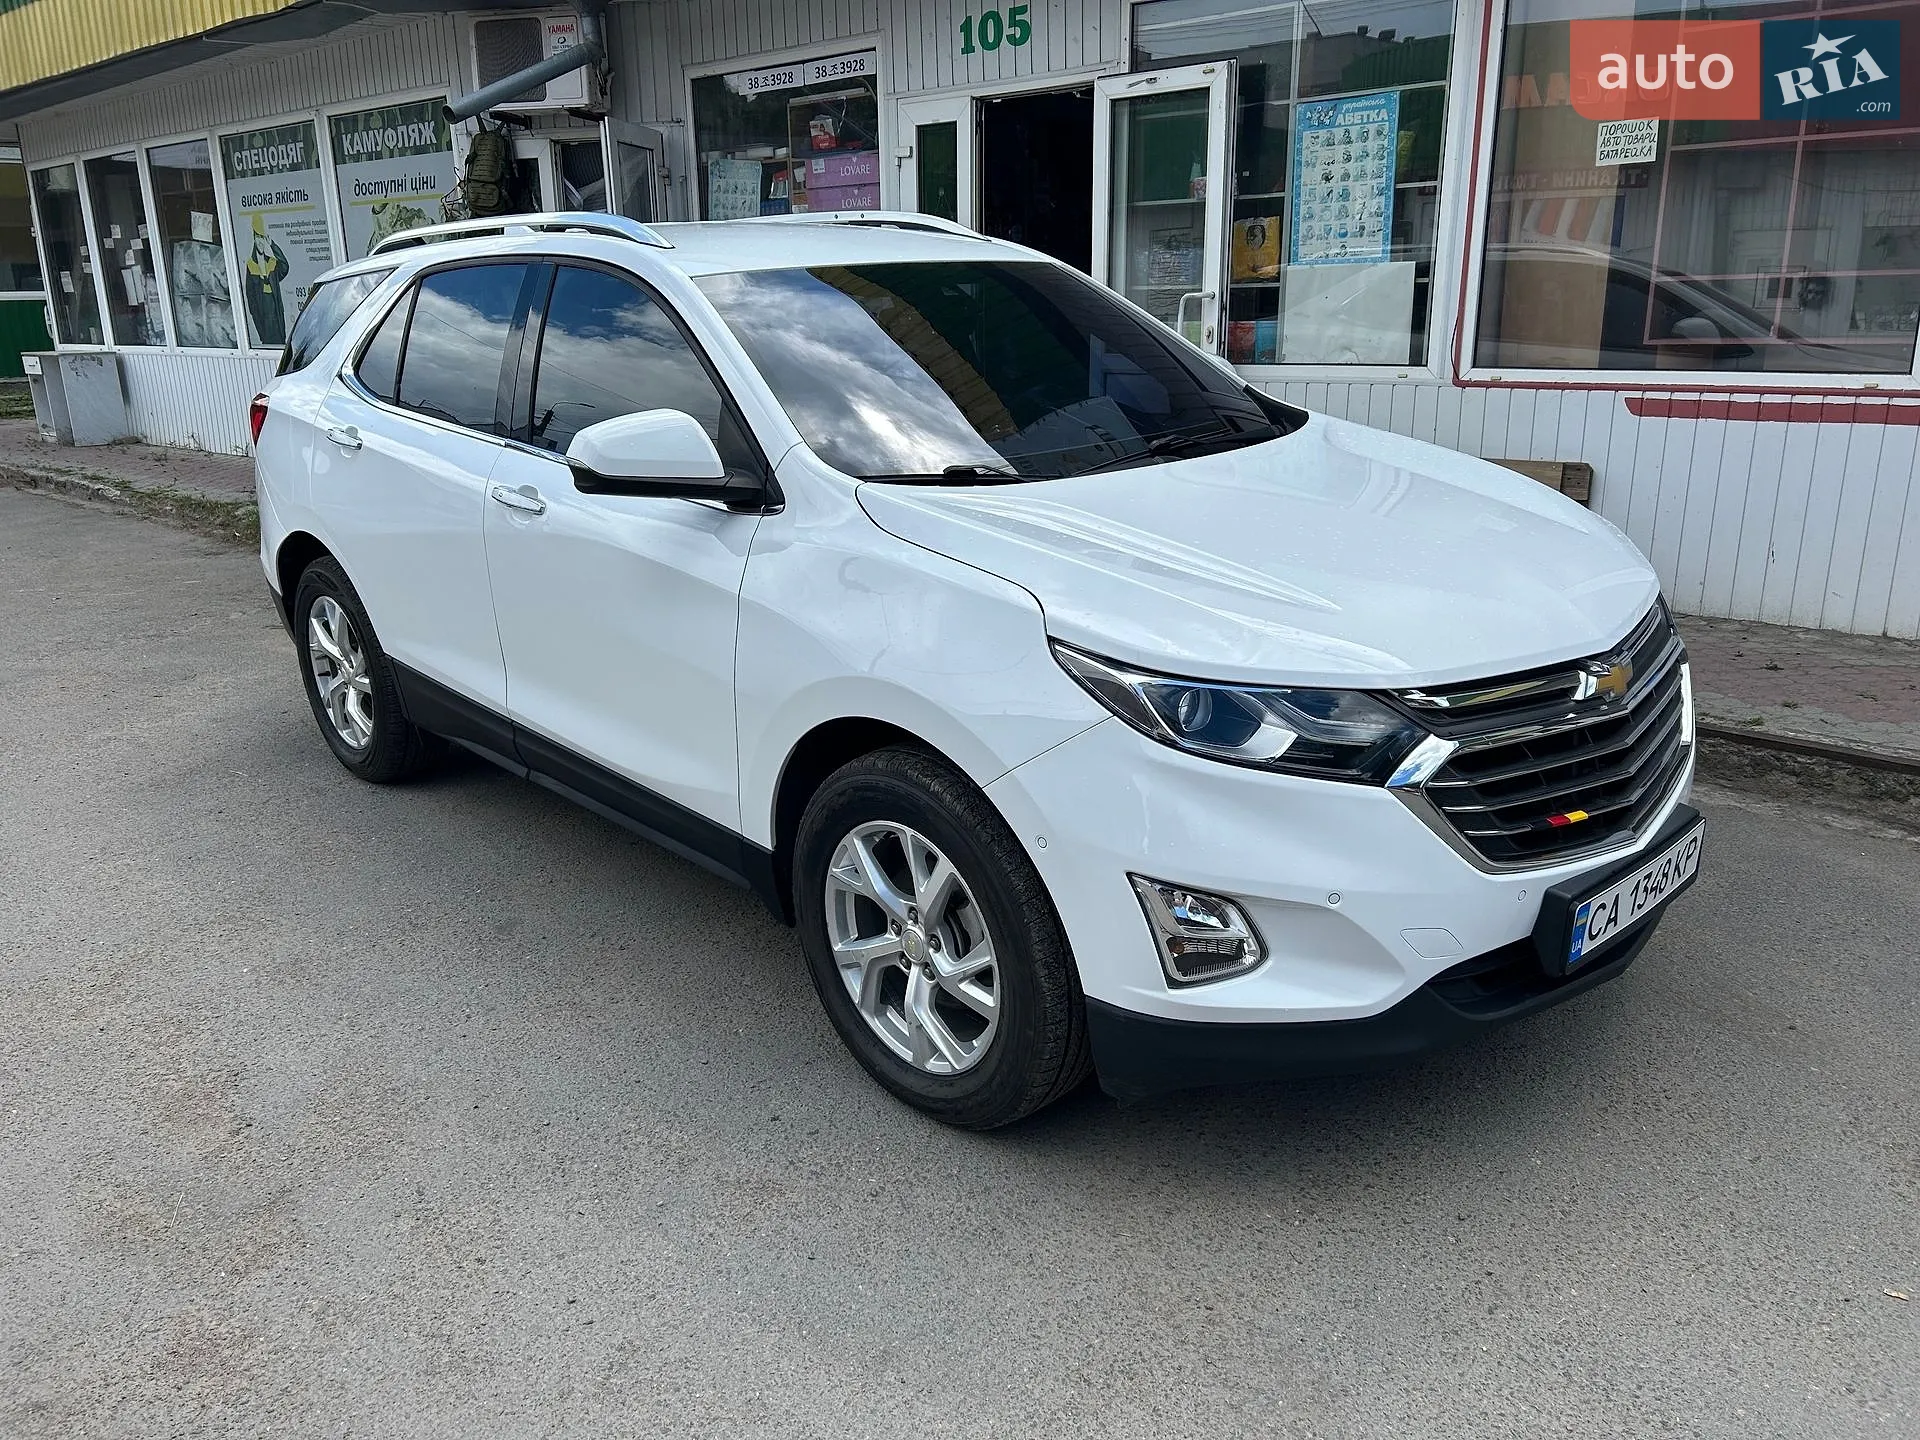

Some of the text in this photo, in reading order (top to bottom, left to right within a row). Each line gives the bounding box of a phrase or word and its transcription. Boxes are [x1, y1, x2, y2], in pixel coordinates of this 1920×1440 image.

[548, 24, 575, 33] YAMAHA
[960, 4, 1031, 55] 105
[814, 58, 865, 79] 38조3928
[748, 71, 794, 90] 38조3928
[1335, 109, 1389, 126] АБЕТКА
[1600, 120, 1653, 136] ПОРОШОК
[342, 121, 437, 155] КАМУФЛЯЖ
[234, 142, 304, 171] СПЕЦОДЯГ
[354, 172, 436, 198] доступні ціни
[241, 186, 309, 208] висока якість
[1588, 836, 1698, 941] CA 1348 KP
[1572, 939, 1582, 953] UA
